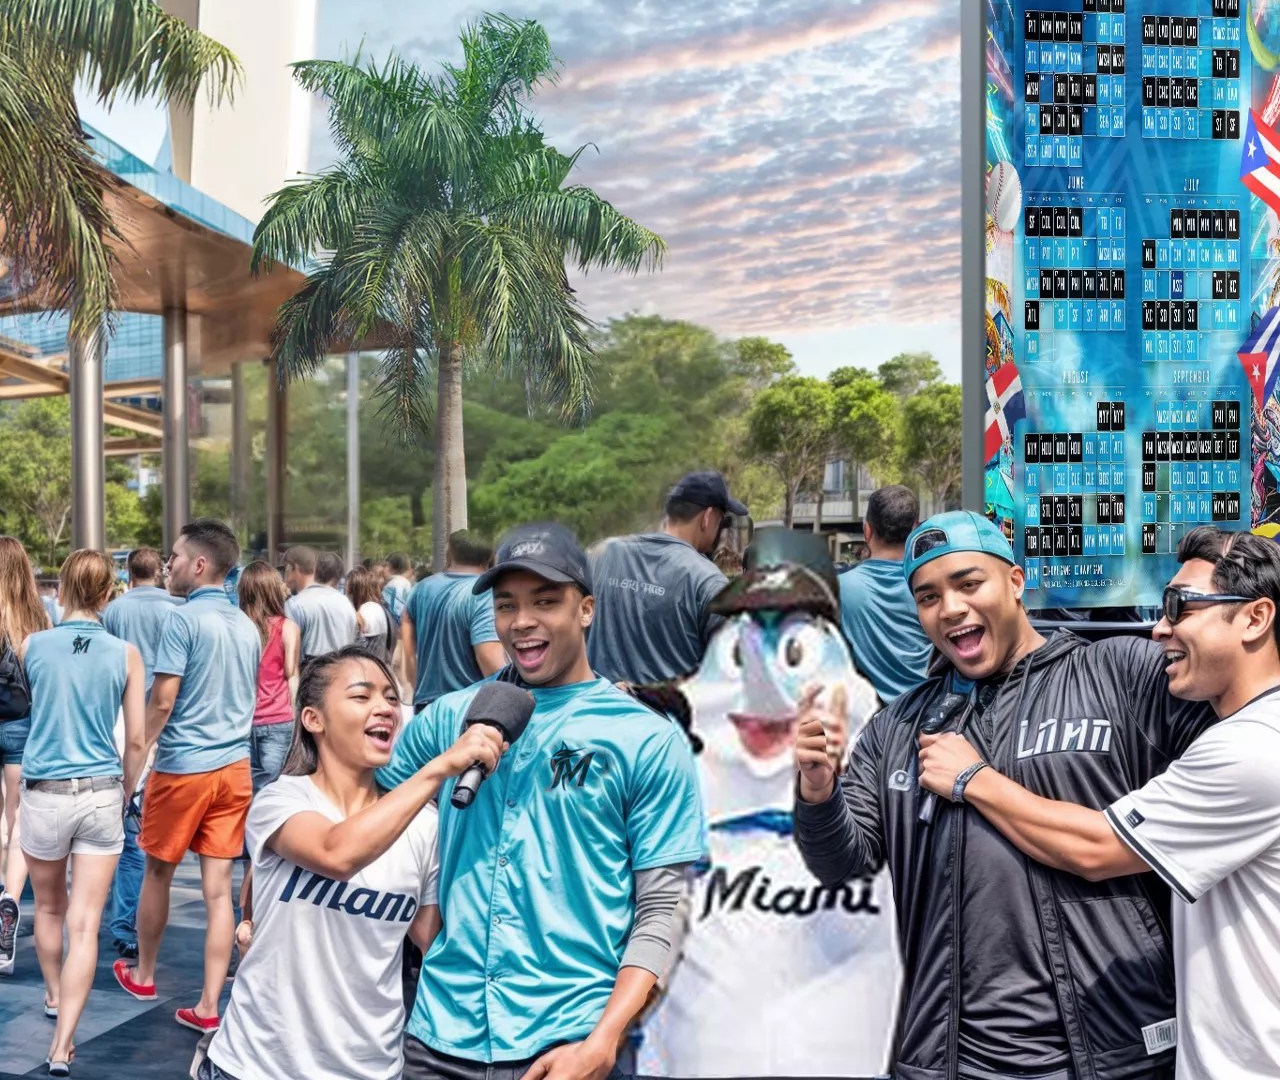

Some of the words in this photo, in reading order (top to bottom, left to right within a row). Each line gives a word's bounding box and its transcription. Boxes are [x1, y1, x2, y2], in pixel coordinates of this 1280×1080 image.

[1068, 176, 1084, 189] JUNE
[1184, 178, 1199, 191] JULY
[1173, 370, 1210, 384] SEPTEMBER
[698, 866, 880, 920] Miami
